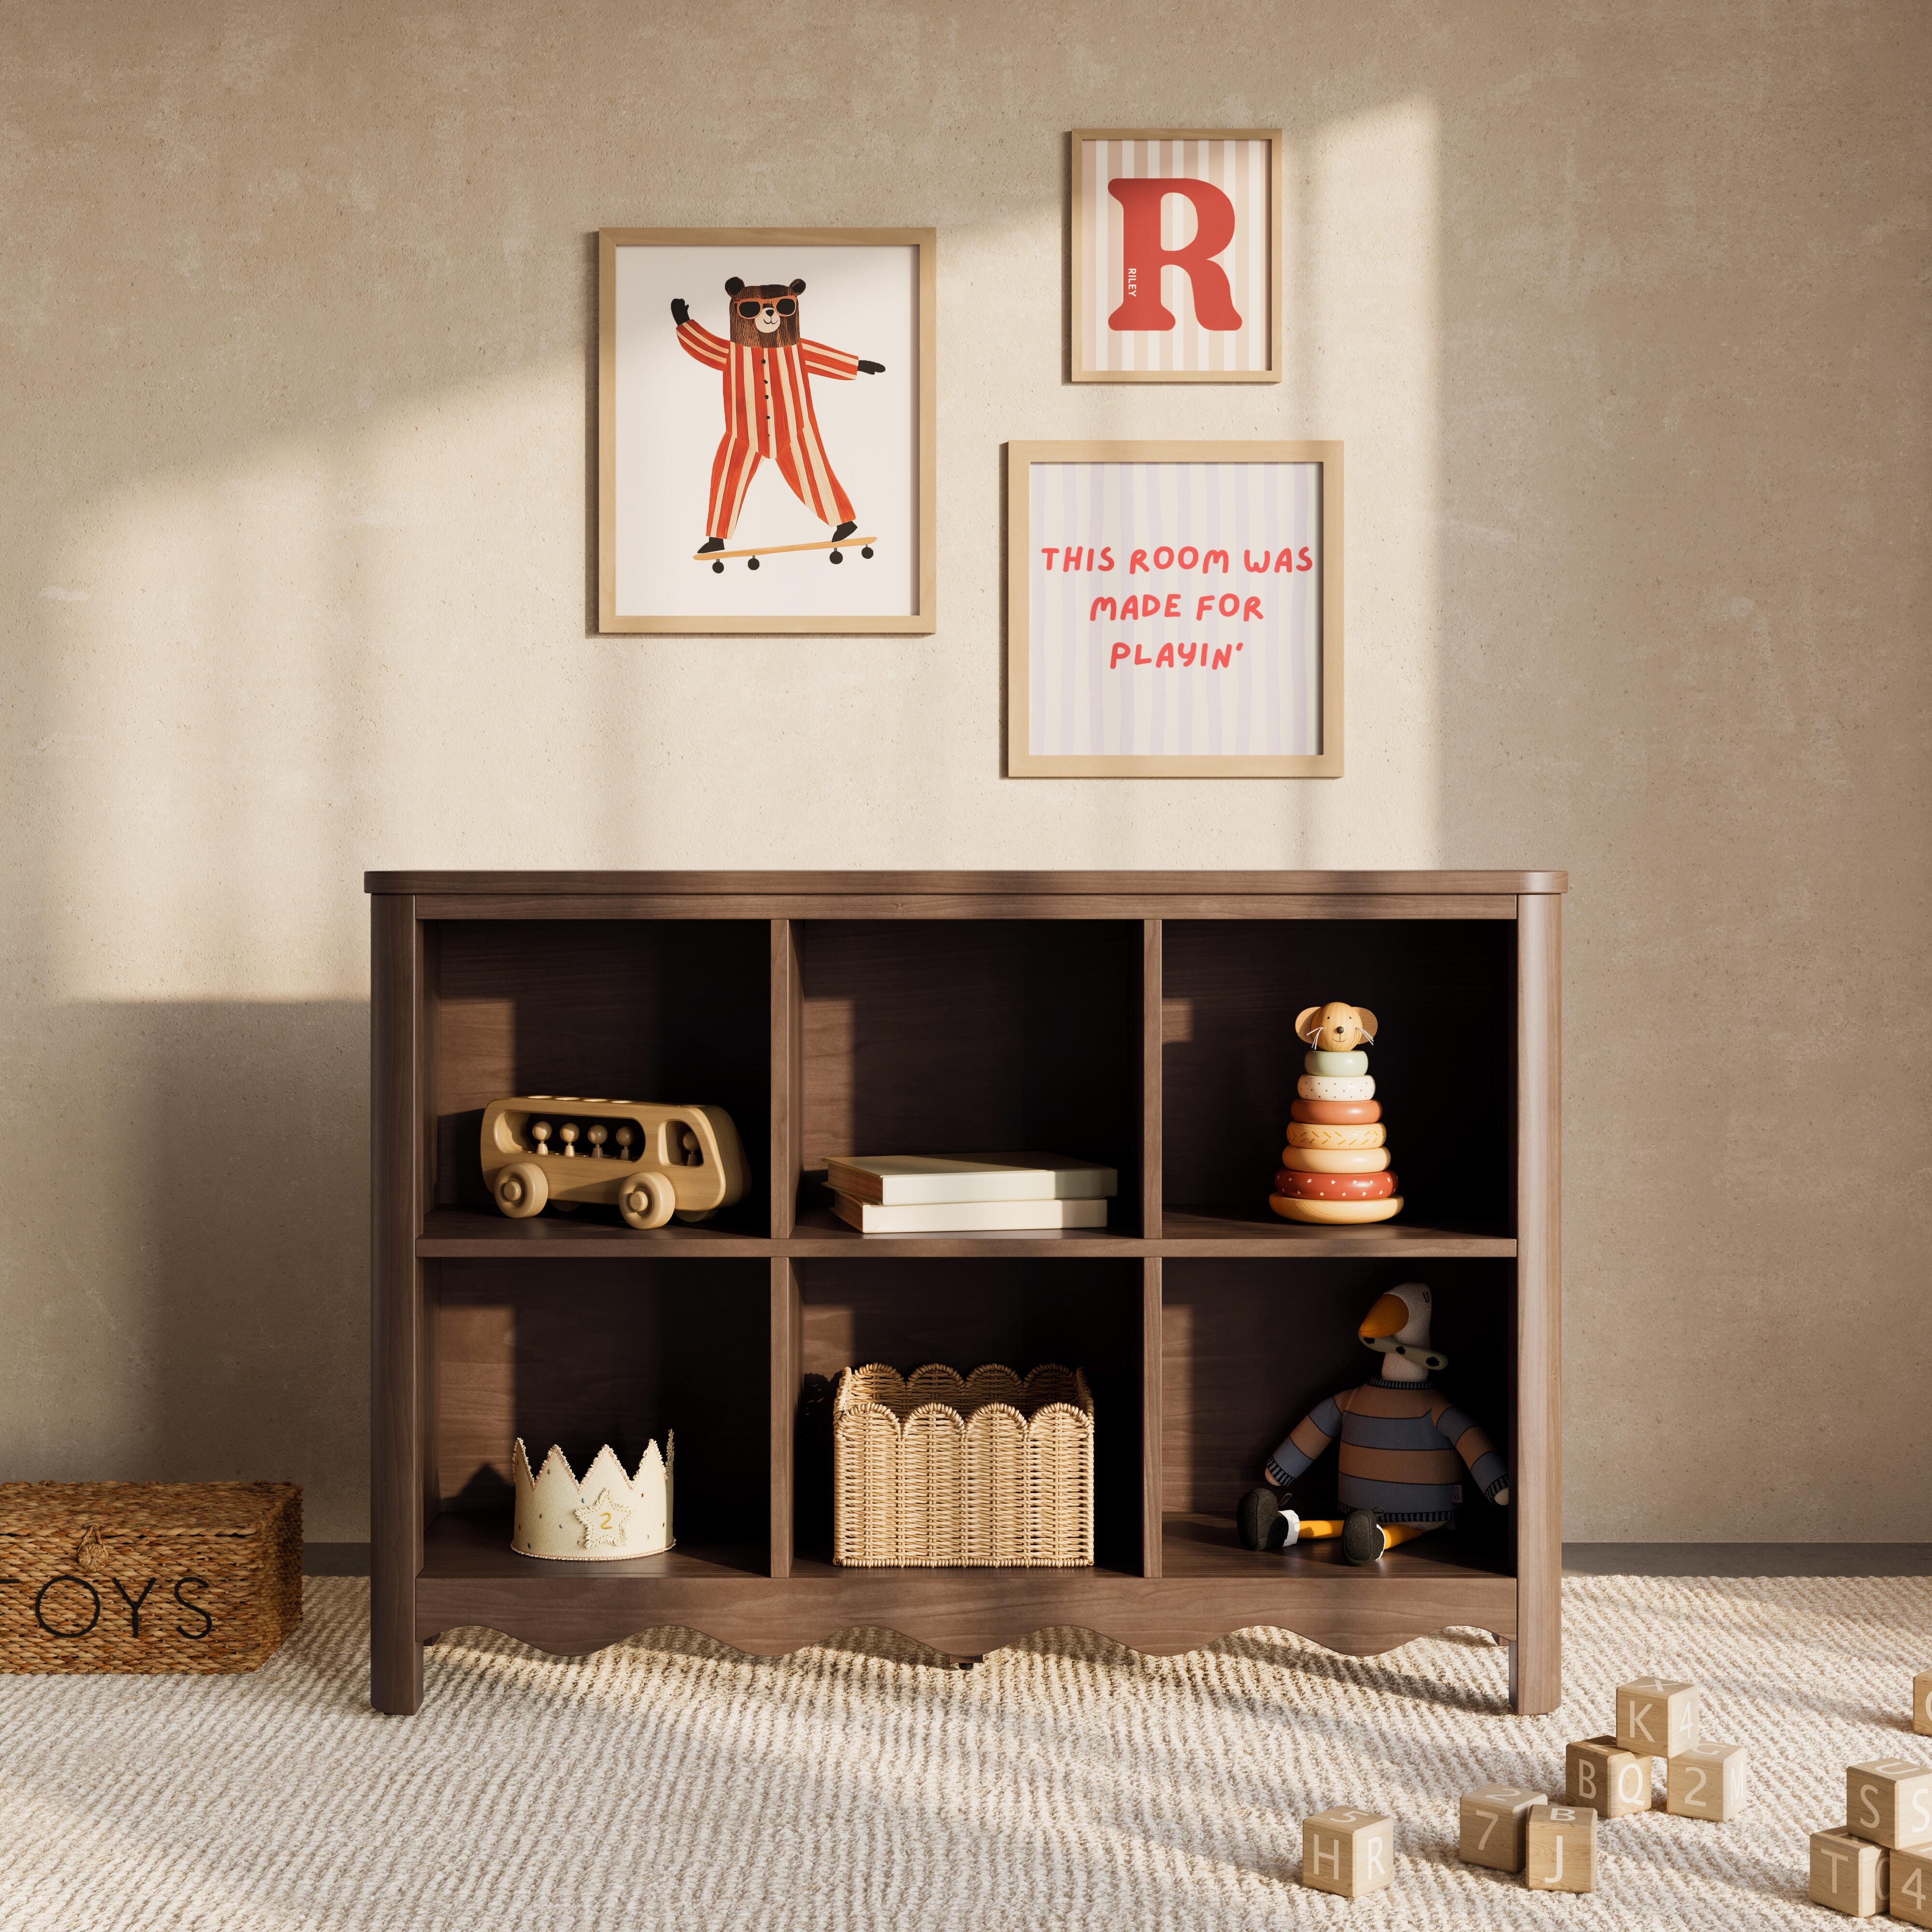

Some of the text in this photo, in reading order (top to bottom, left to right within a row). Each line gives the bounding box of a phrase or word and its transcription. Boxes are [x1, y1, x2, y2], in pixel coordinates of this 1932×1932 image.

[1108, 178, 1243, 331] R
[1128, 268, 1136, 297] RILEY
[1041, 546, 1313, 574] THIS ROOM WAS
[1090, 593, 1264, 622] MADE FOR
[600, 1512, 612, 1529] 2
[1637, 1679, 1680, 1692] X
[1630, 1700, 1655, 1743] K
[1679, 1701, 1693, 1739] 4
[1485, 1788, 1521, 1802] 2
[1579, 1758, 1596, 1799] B
[1618, 1763, 1645, 1806] Q
[1684, 1766, 1707, 1807] 2
[1731, 1761, 1744, 1806] M
[1329, 1810, 1370, 1823] 5
[1550, 1808, 1576, 1821] B
[1860, 1784, 1880, 1829] S
[1912, 1788, 1931, 1833] S
[1475, 1809, 1499, 1851] 7
[1314, 1833, 1339, 1880] H
[1367, 1836, 1386, 1880] R
[1545, 1835, 1563, 1883] J
[1820, 1848, 1848, 1894] T
[1901, 1867, 1926, 1911] 4
